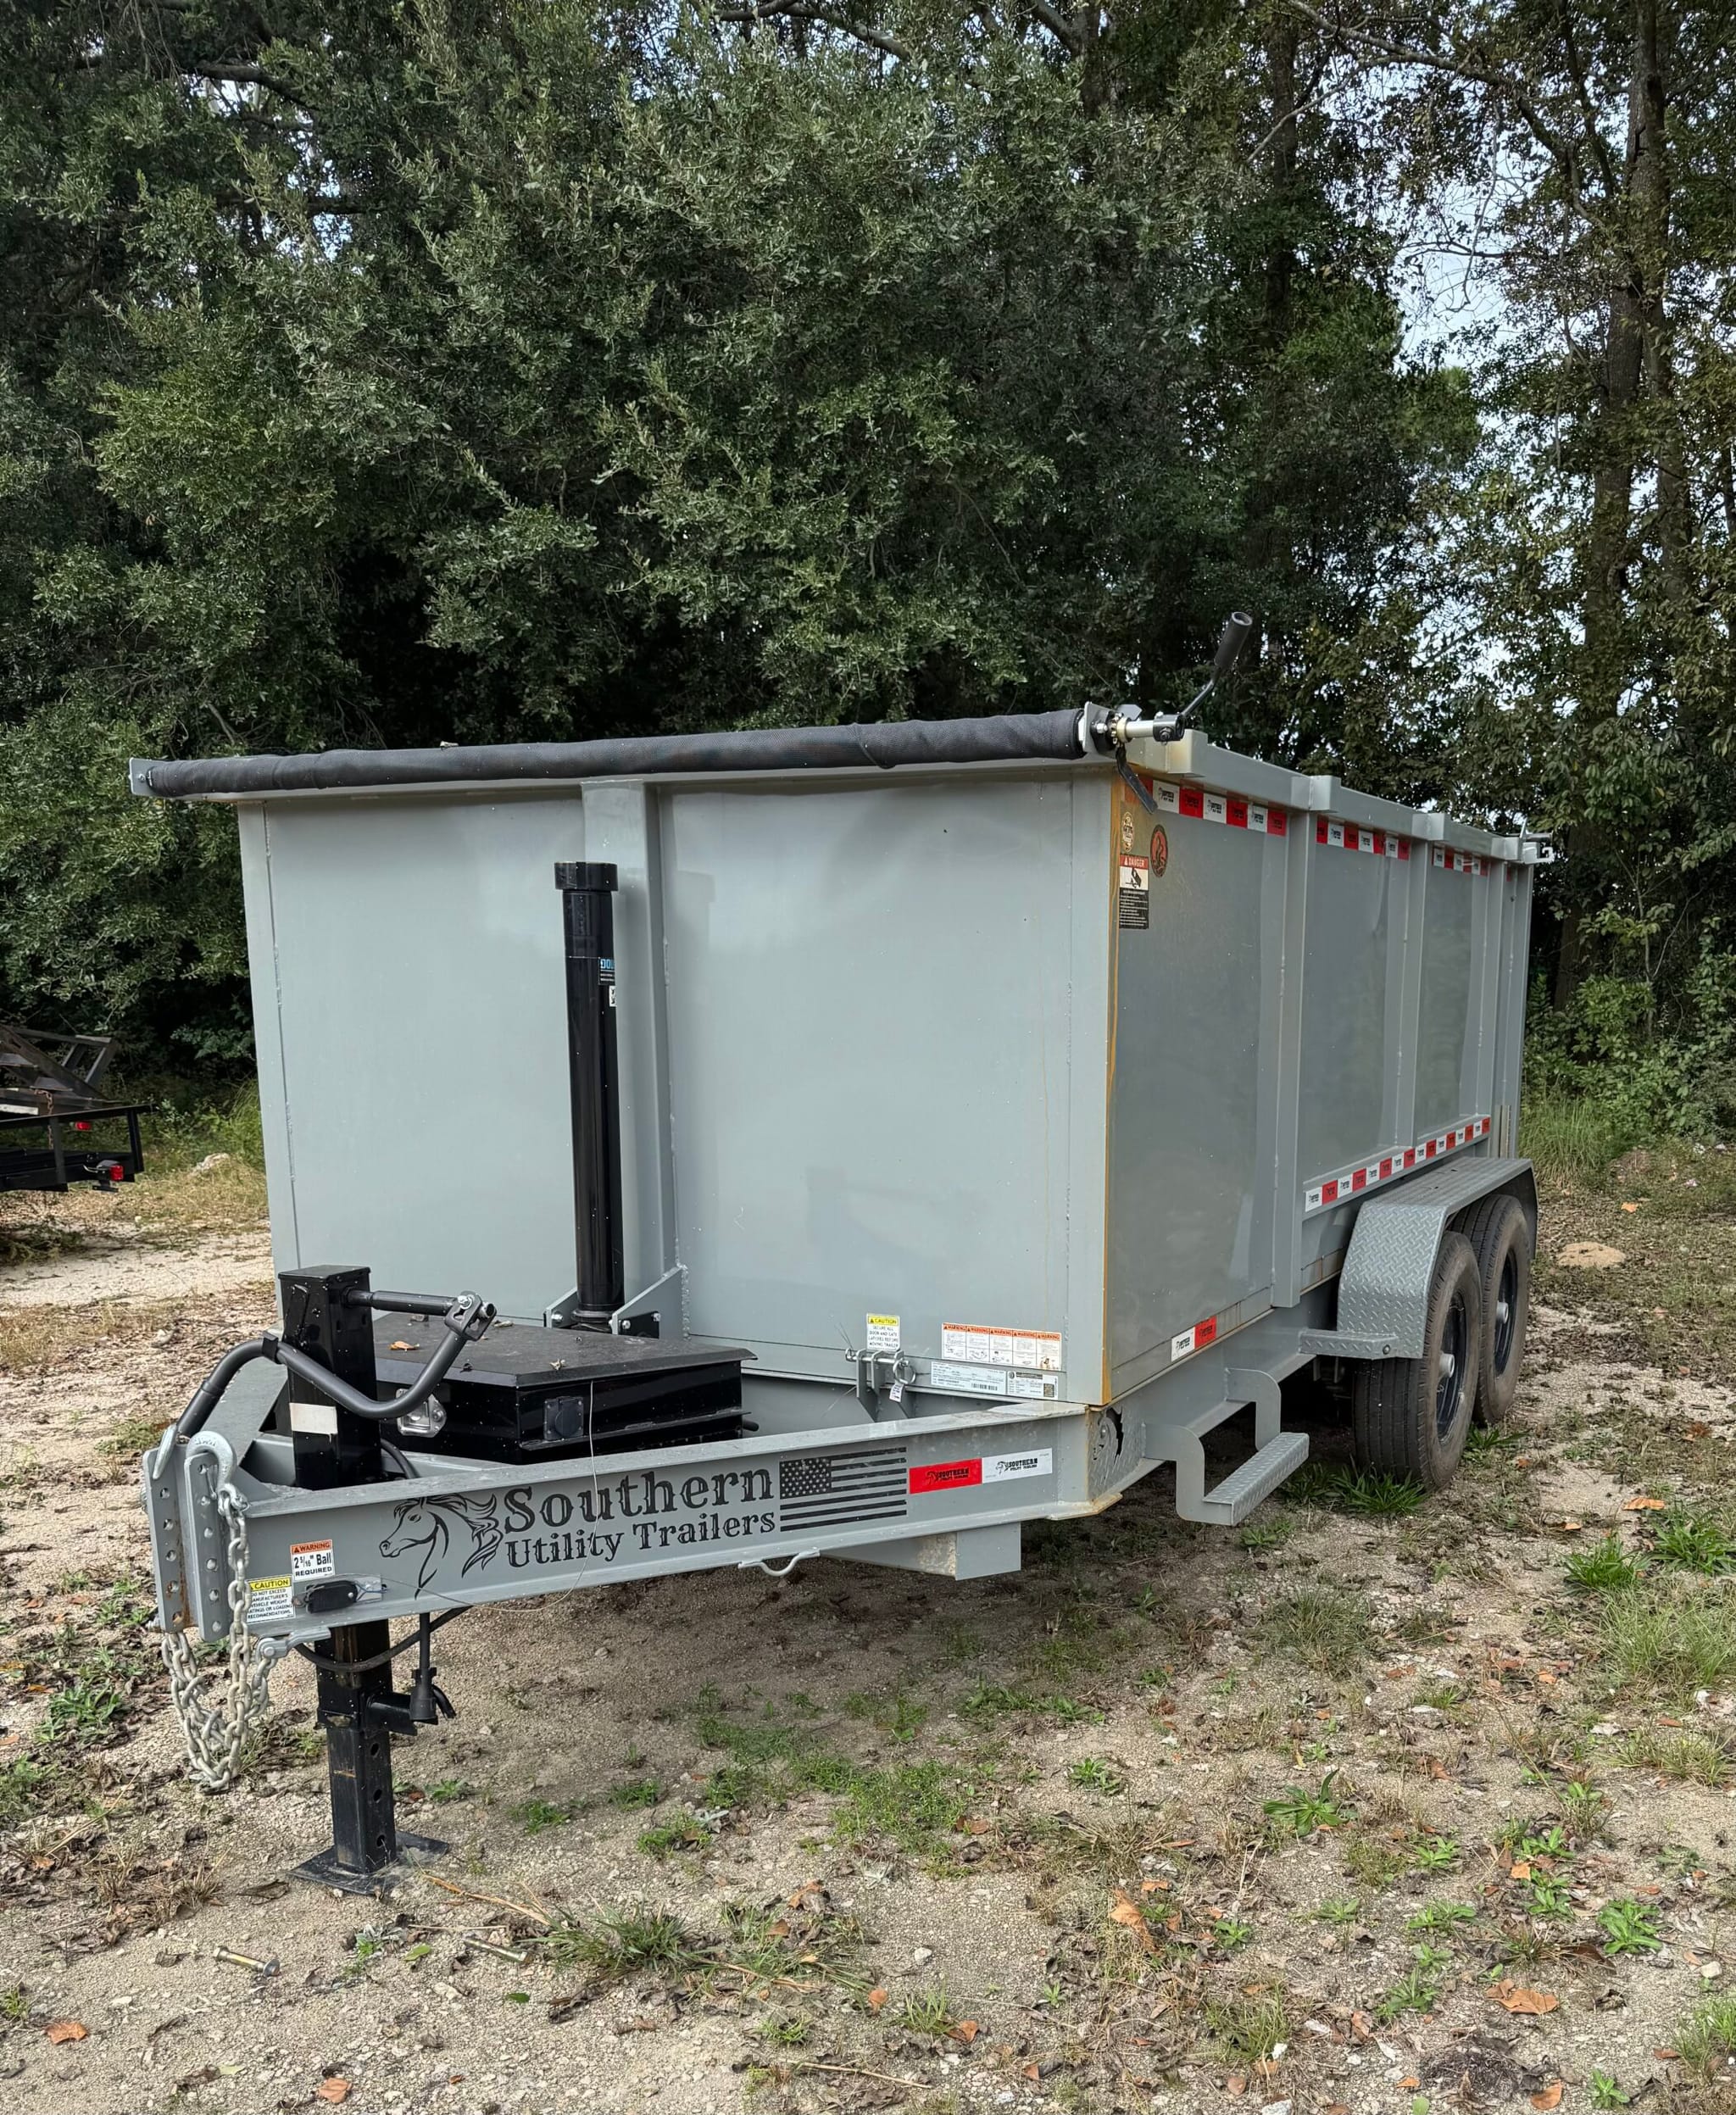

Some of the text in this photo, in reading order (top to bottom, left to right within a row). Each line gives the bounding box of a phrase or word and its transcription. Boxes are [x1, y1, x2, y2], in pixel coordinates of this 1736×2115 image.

[1128, 857, 1144, 867] DANGER
[504, 1467, 775, 1533] Southern
[505, 1511, 776, 1568] Utility Trailers
[299, 1542, 331, 1551] WARNING
[316, 1552, 331, 1566] Ball
[295, 1567, 332, 1577] REQUIRED
[254, 1579, 288, 1589] CAUTION
[253, 1594, 288, 1602] ANUFACTURER'S
